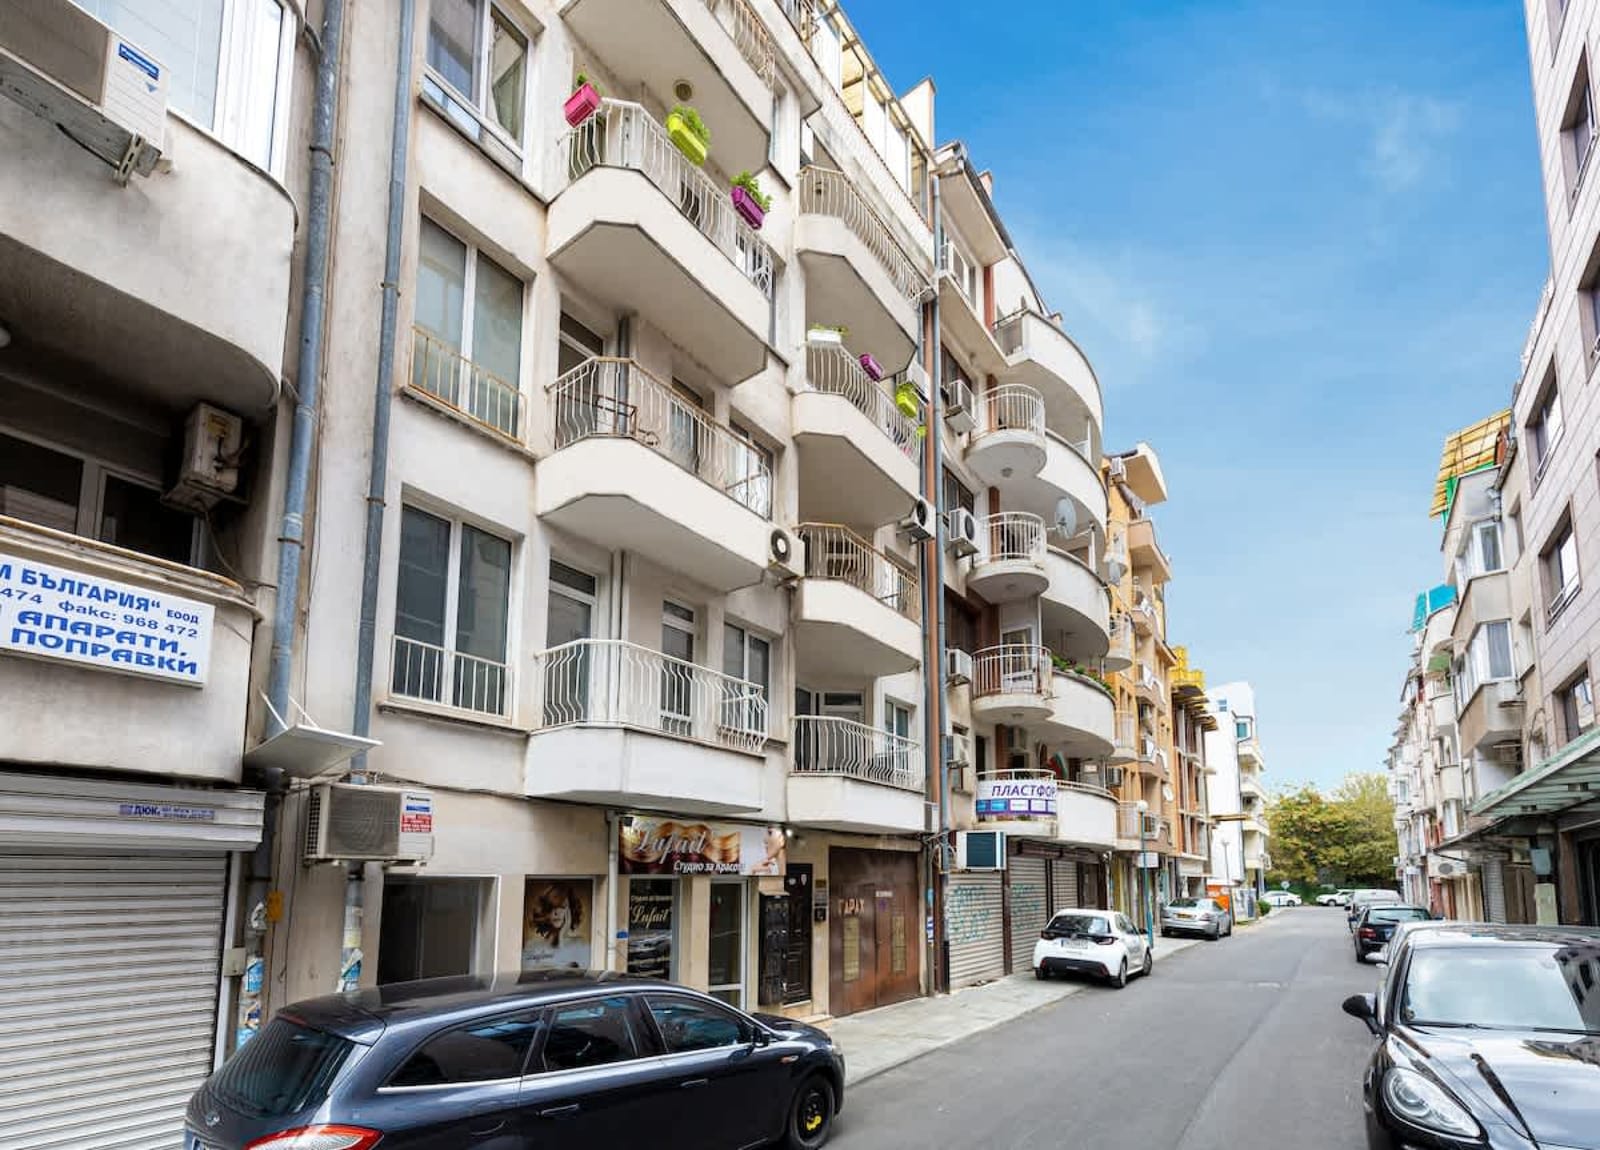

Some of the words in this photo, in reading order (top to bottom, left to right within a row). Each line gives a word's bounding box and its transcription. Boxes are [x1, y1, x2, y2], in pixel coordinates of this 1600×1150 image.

[123, 614, 159, 630] 968
[164, 624, 198, 638] 472
[167, 609, 199, 625] ЕООД
[18, 611, 187, 656] АПАРАТИ,
[11, 627, 197, 675] ПОПРАВКИ
[704, 863, 714, 871] за
